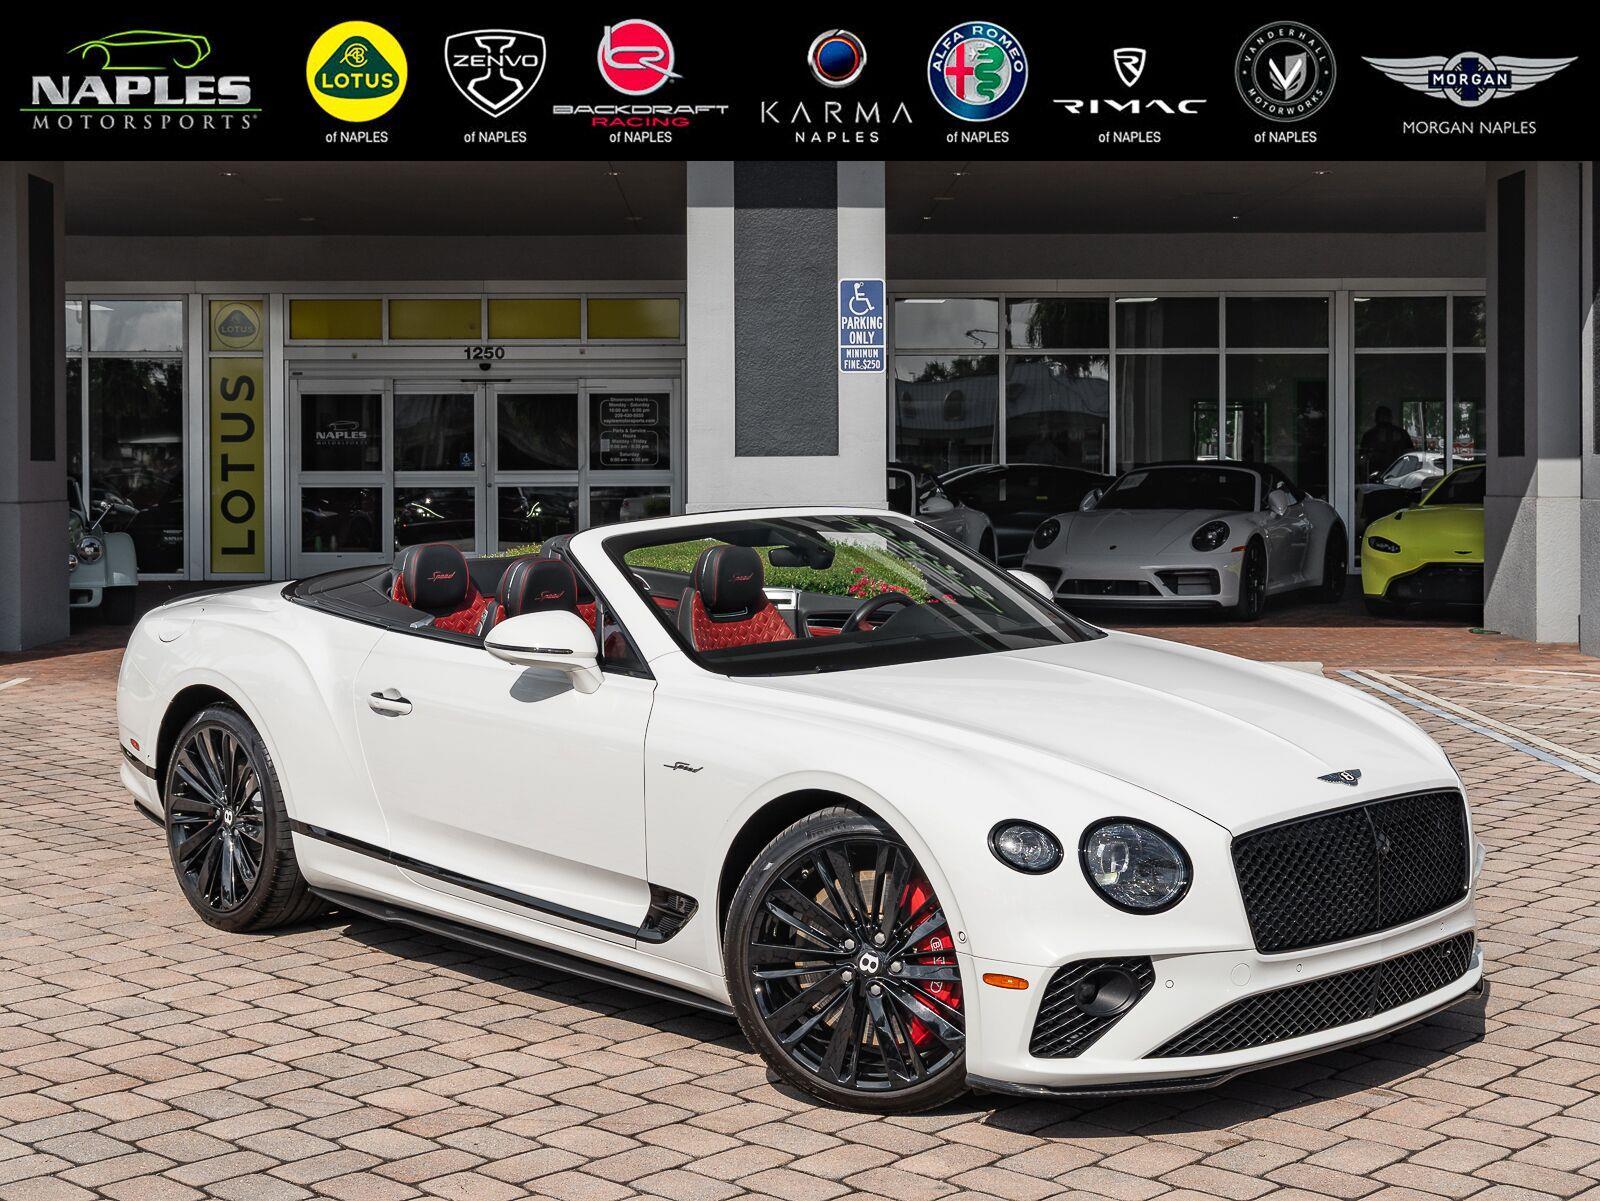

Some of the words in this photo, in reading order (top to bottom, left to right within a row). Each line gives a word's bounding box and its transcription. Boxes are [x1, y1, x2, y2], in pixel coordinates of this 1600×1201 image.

[221, 326, 254, 334] LOTUS
[841, 316, 883, 330] PARKING
[848, 331, 875, 345] ONLY
[464, 346, 505, 360] 1250
[846, 349, 879, 358] MINIMUM
[315, 431, 368, 440] NAPLES
[220, 375, 256, 555] LOTUS
